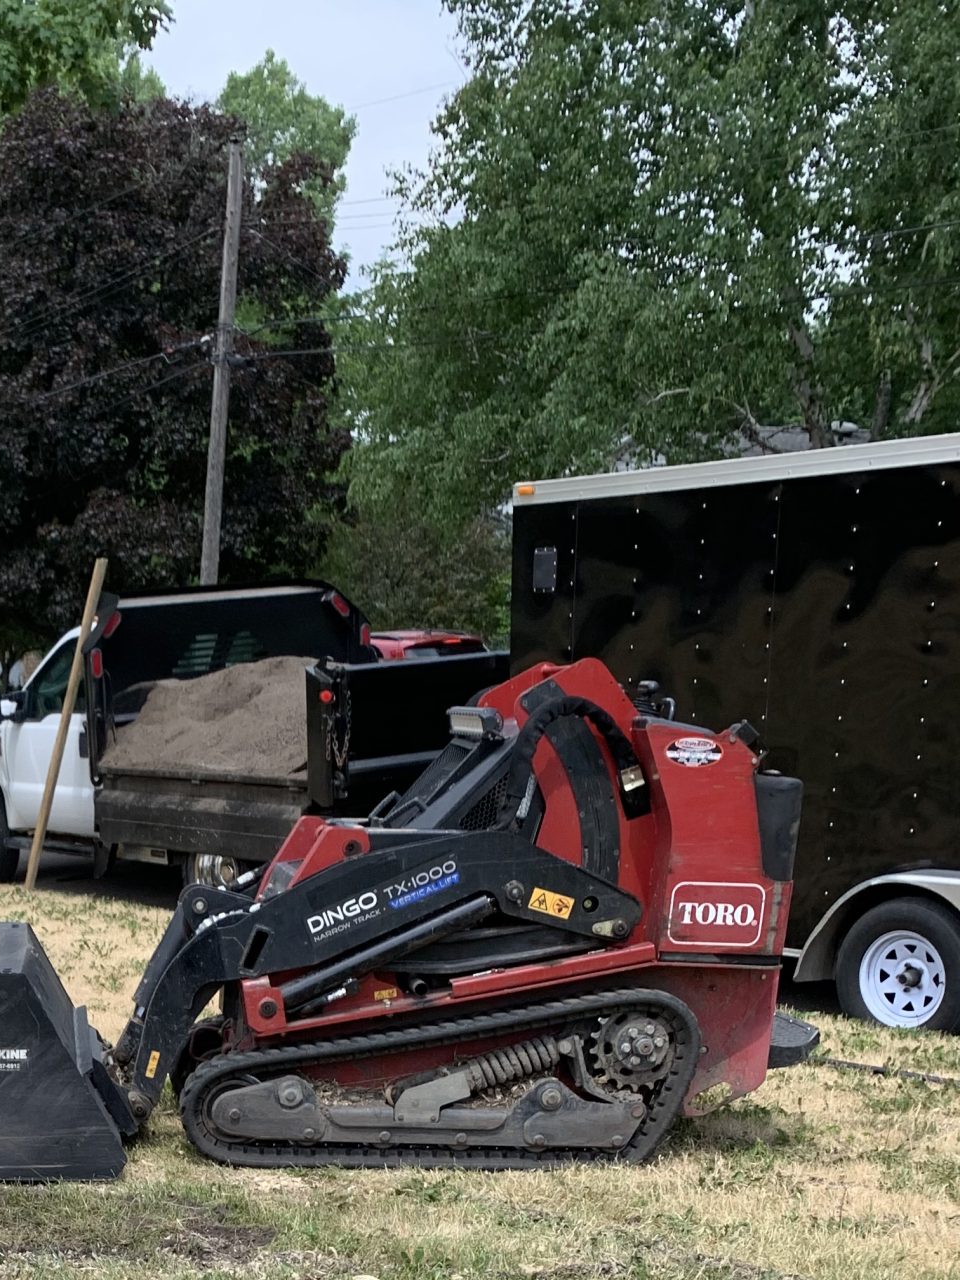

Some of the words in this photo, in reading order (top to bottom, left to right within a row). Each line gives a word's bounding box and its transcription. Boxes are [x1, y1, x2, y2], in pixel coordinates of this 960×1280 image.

[307, 891, 378, 934] DINGO
[313, 921, 352, 943] NARROW
[353, 908, 381, 925] TRACK
[390, 883, 439, 908] VERTICAL
[439, 874, 459, 889] LIFT
[678, 902, 755, 926] TORO
